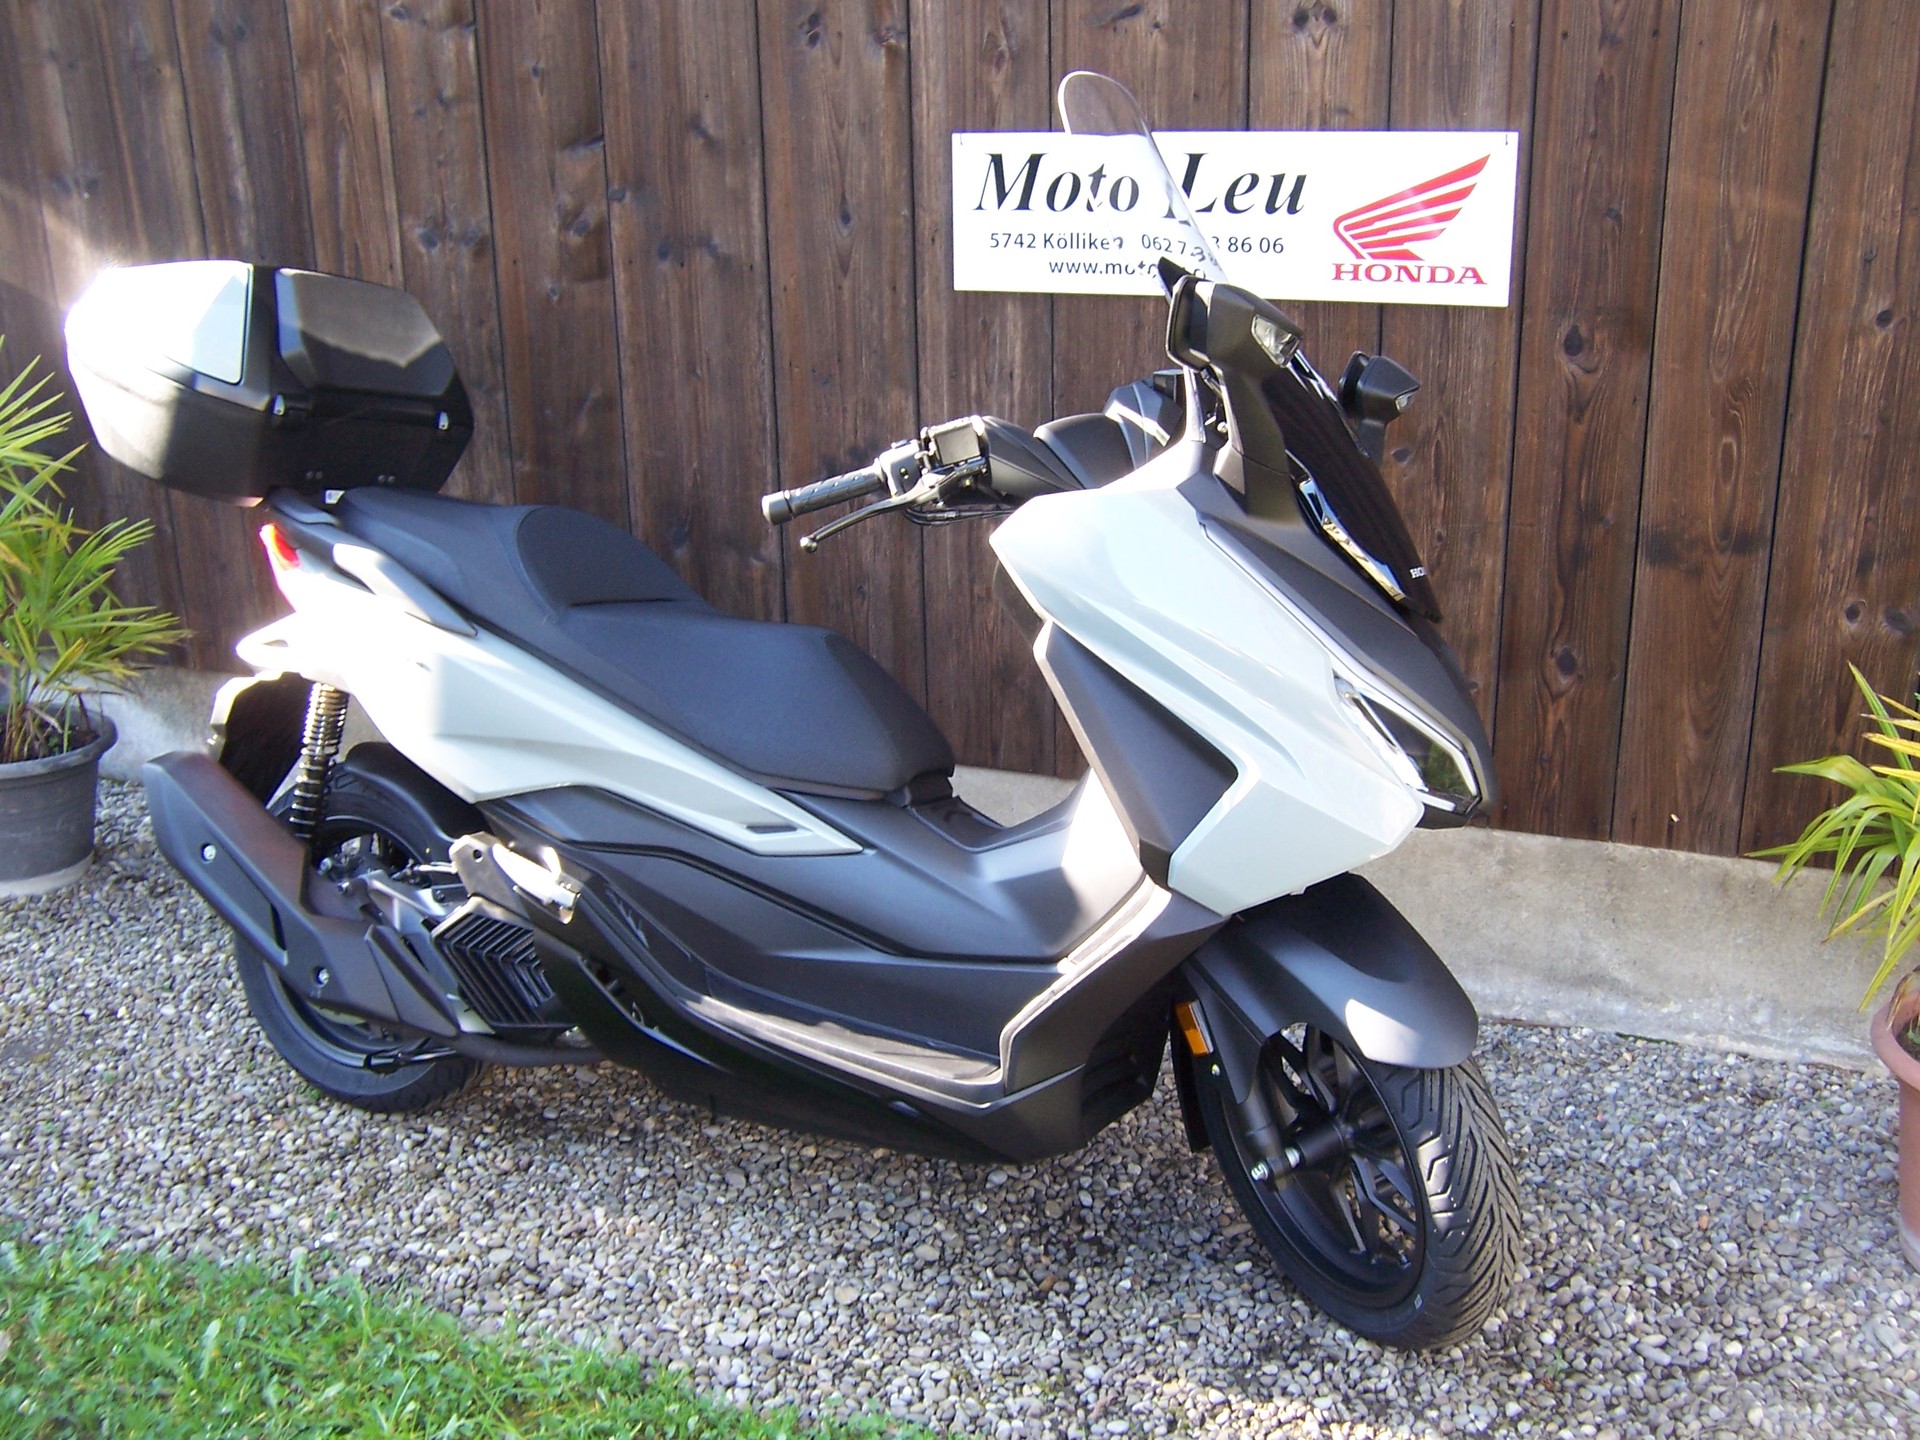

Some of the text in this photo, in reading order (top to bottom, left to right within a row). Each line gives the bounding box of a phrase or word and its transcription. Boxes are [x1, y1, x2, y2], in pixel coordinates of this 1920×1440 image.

[972, 152, 1307, 218] Moto Leu
[990, 232, 1037, 249] 5742
[1141, 233, 1173, 253] 062
[1228, 236, 1252, 253] 86
[1259, 237, 1284, 253] 06
[1332, 263, 1488, 285] HONDA
